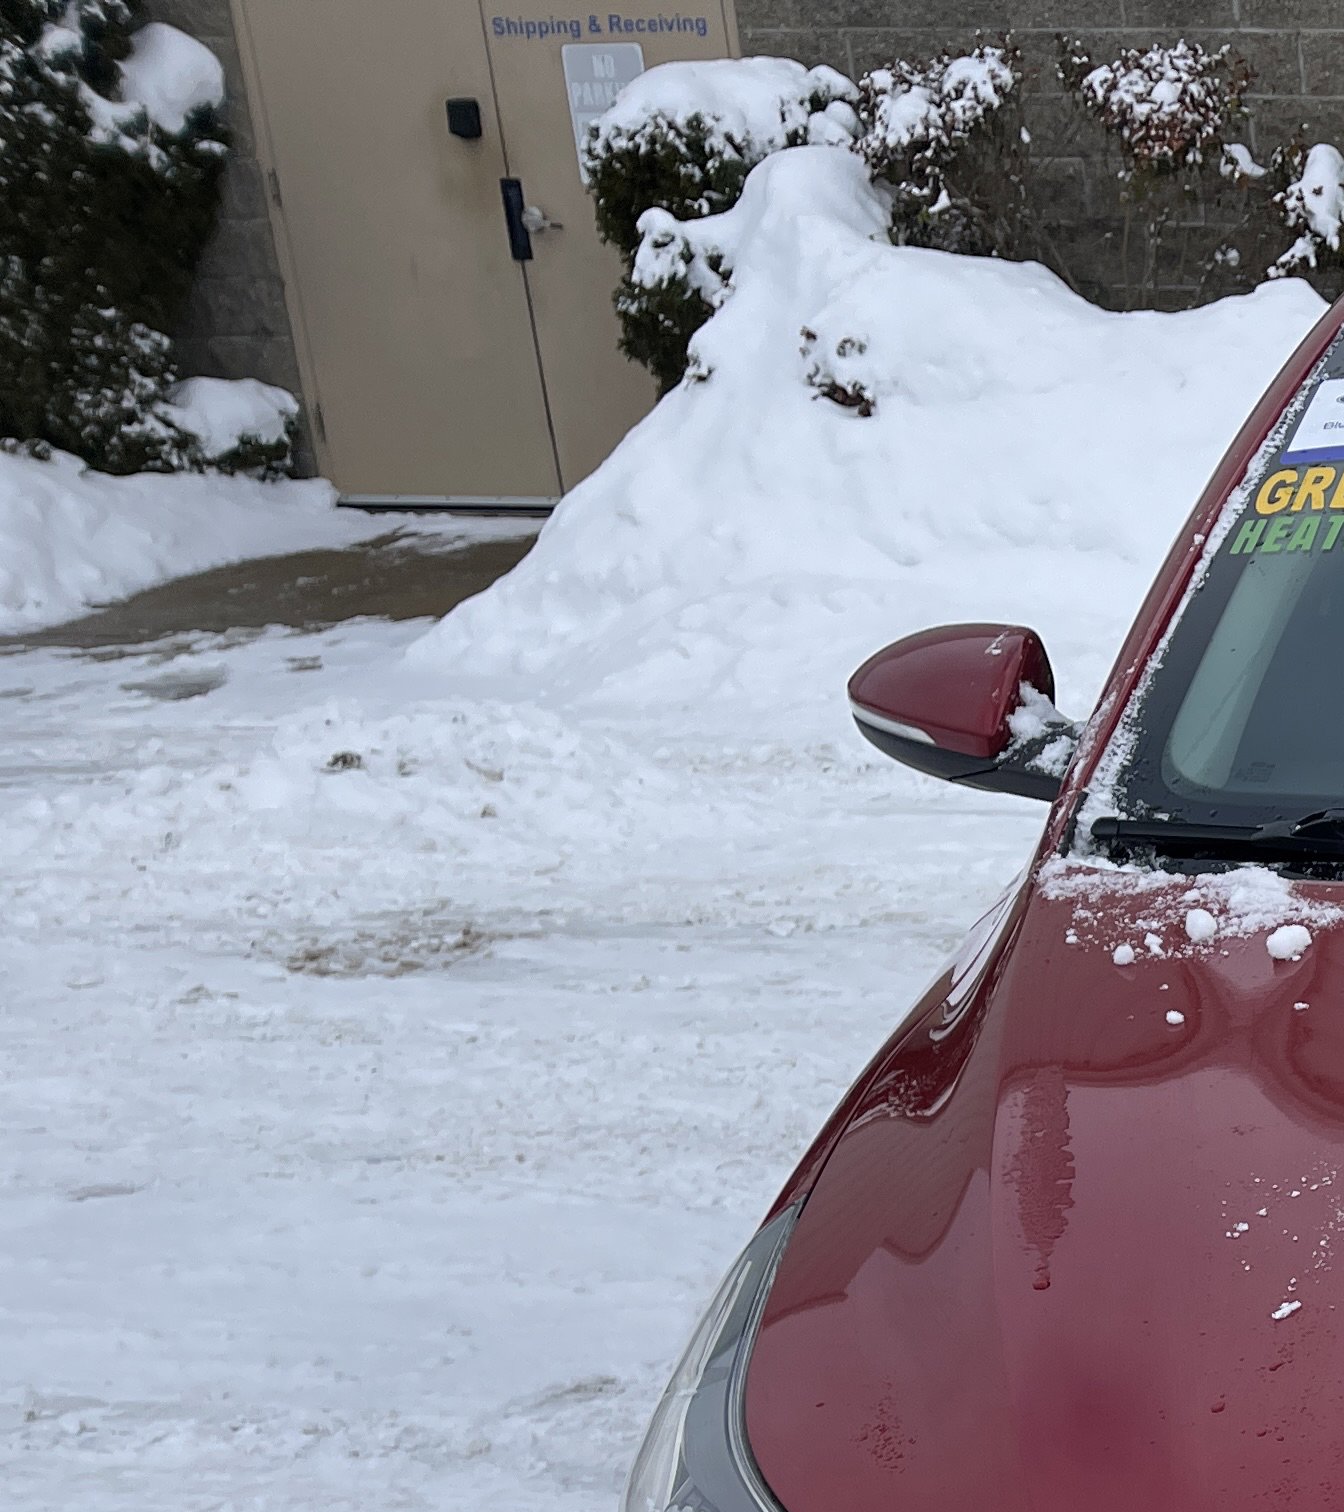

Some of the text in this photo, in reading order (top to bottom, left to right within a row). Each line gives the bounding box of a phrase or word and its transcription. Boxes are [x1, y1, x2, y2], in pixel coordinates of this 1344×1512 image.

[492, 13, 707, 39] Shipping & Receiving
[592, 54, 615, 78] NO
[571, 82, 624, 107] PARK
